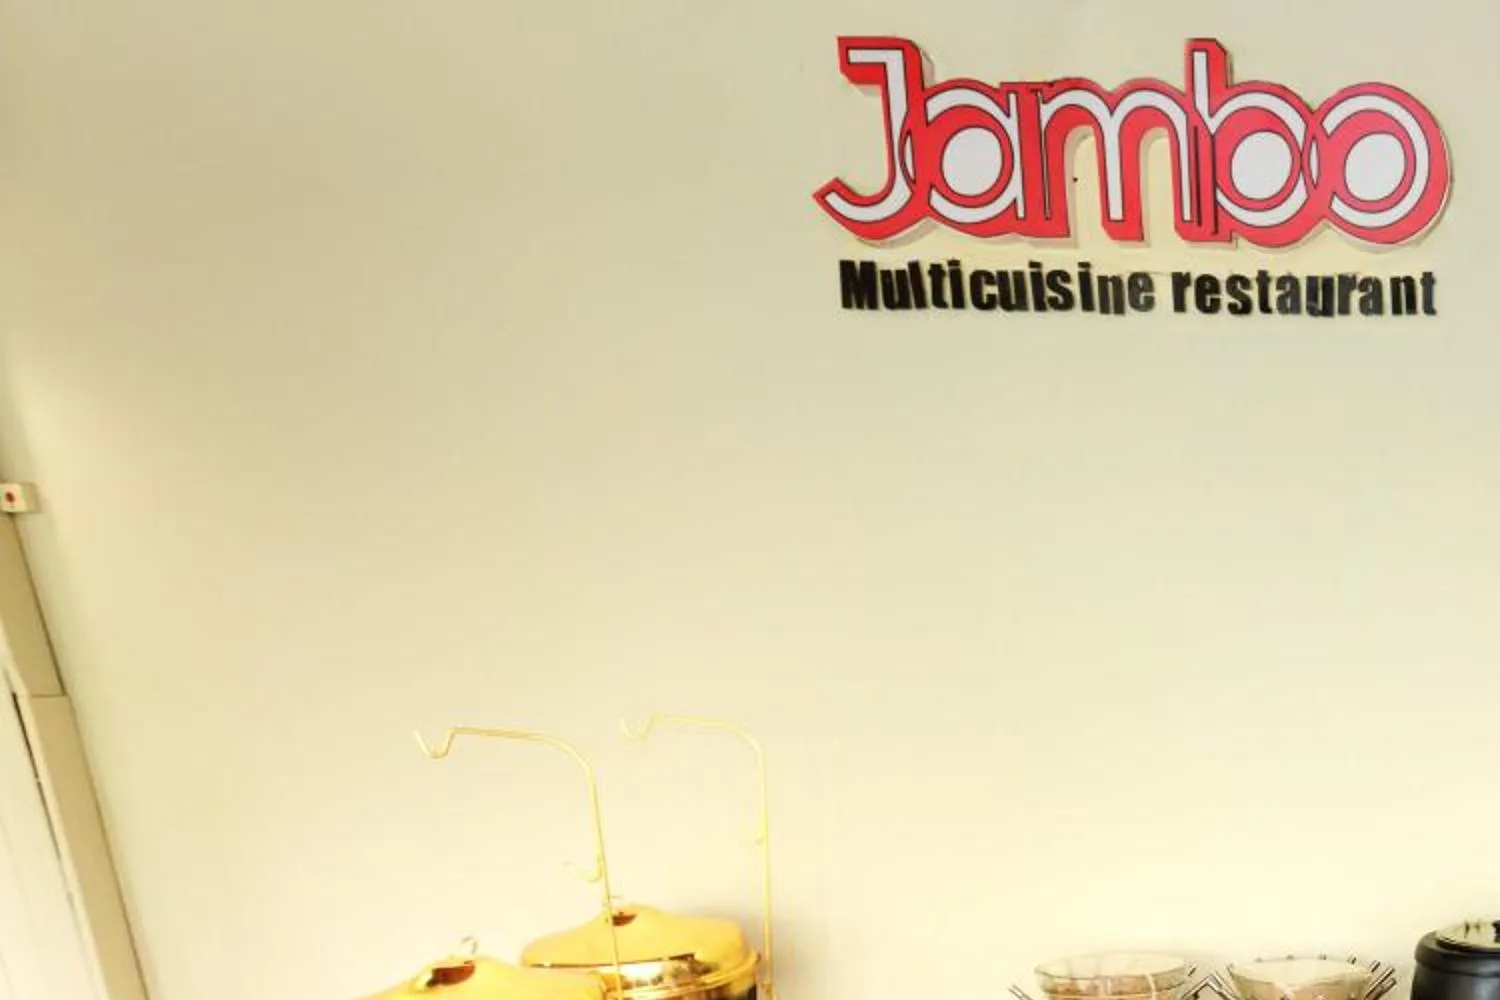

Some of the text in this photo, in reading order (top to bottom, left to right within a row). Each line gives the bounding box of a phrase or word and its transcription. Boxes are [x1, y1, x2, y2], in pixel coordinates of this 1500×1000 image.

[813, 36, 1450, 247] Jambo
[838, 259, 1437, 318] Multicuisine restaurant
